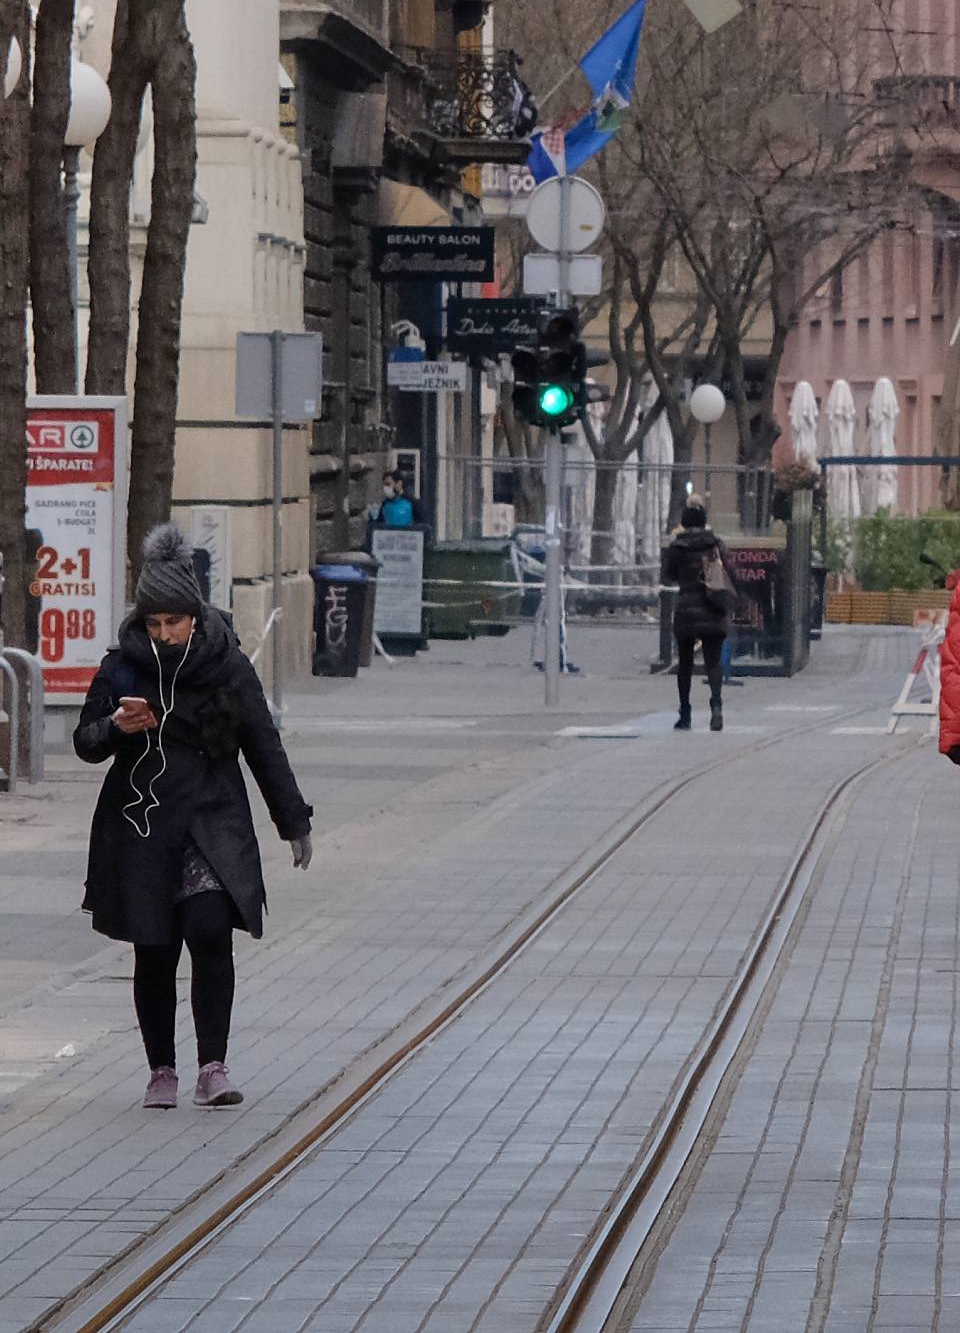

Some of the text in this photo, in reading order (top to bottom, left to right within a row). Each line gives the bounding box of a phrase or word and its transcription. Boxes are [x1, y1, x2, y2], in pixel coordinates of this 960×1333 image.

[387, 234, 481, 244] BEAUTY SALON
[36, 546, 91, 579] 2+1
[29, 581, 96, 596] GRATIS!
